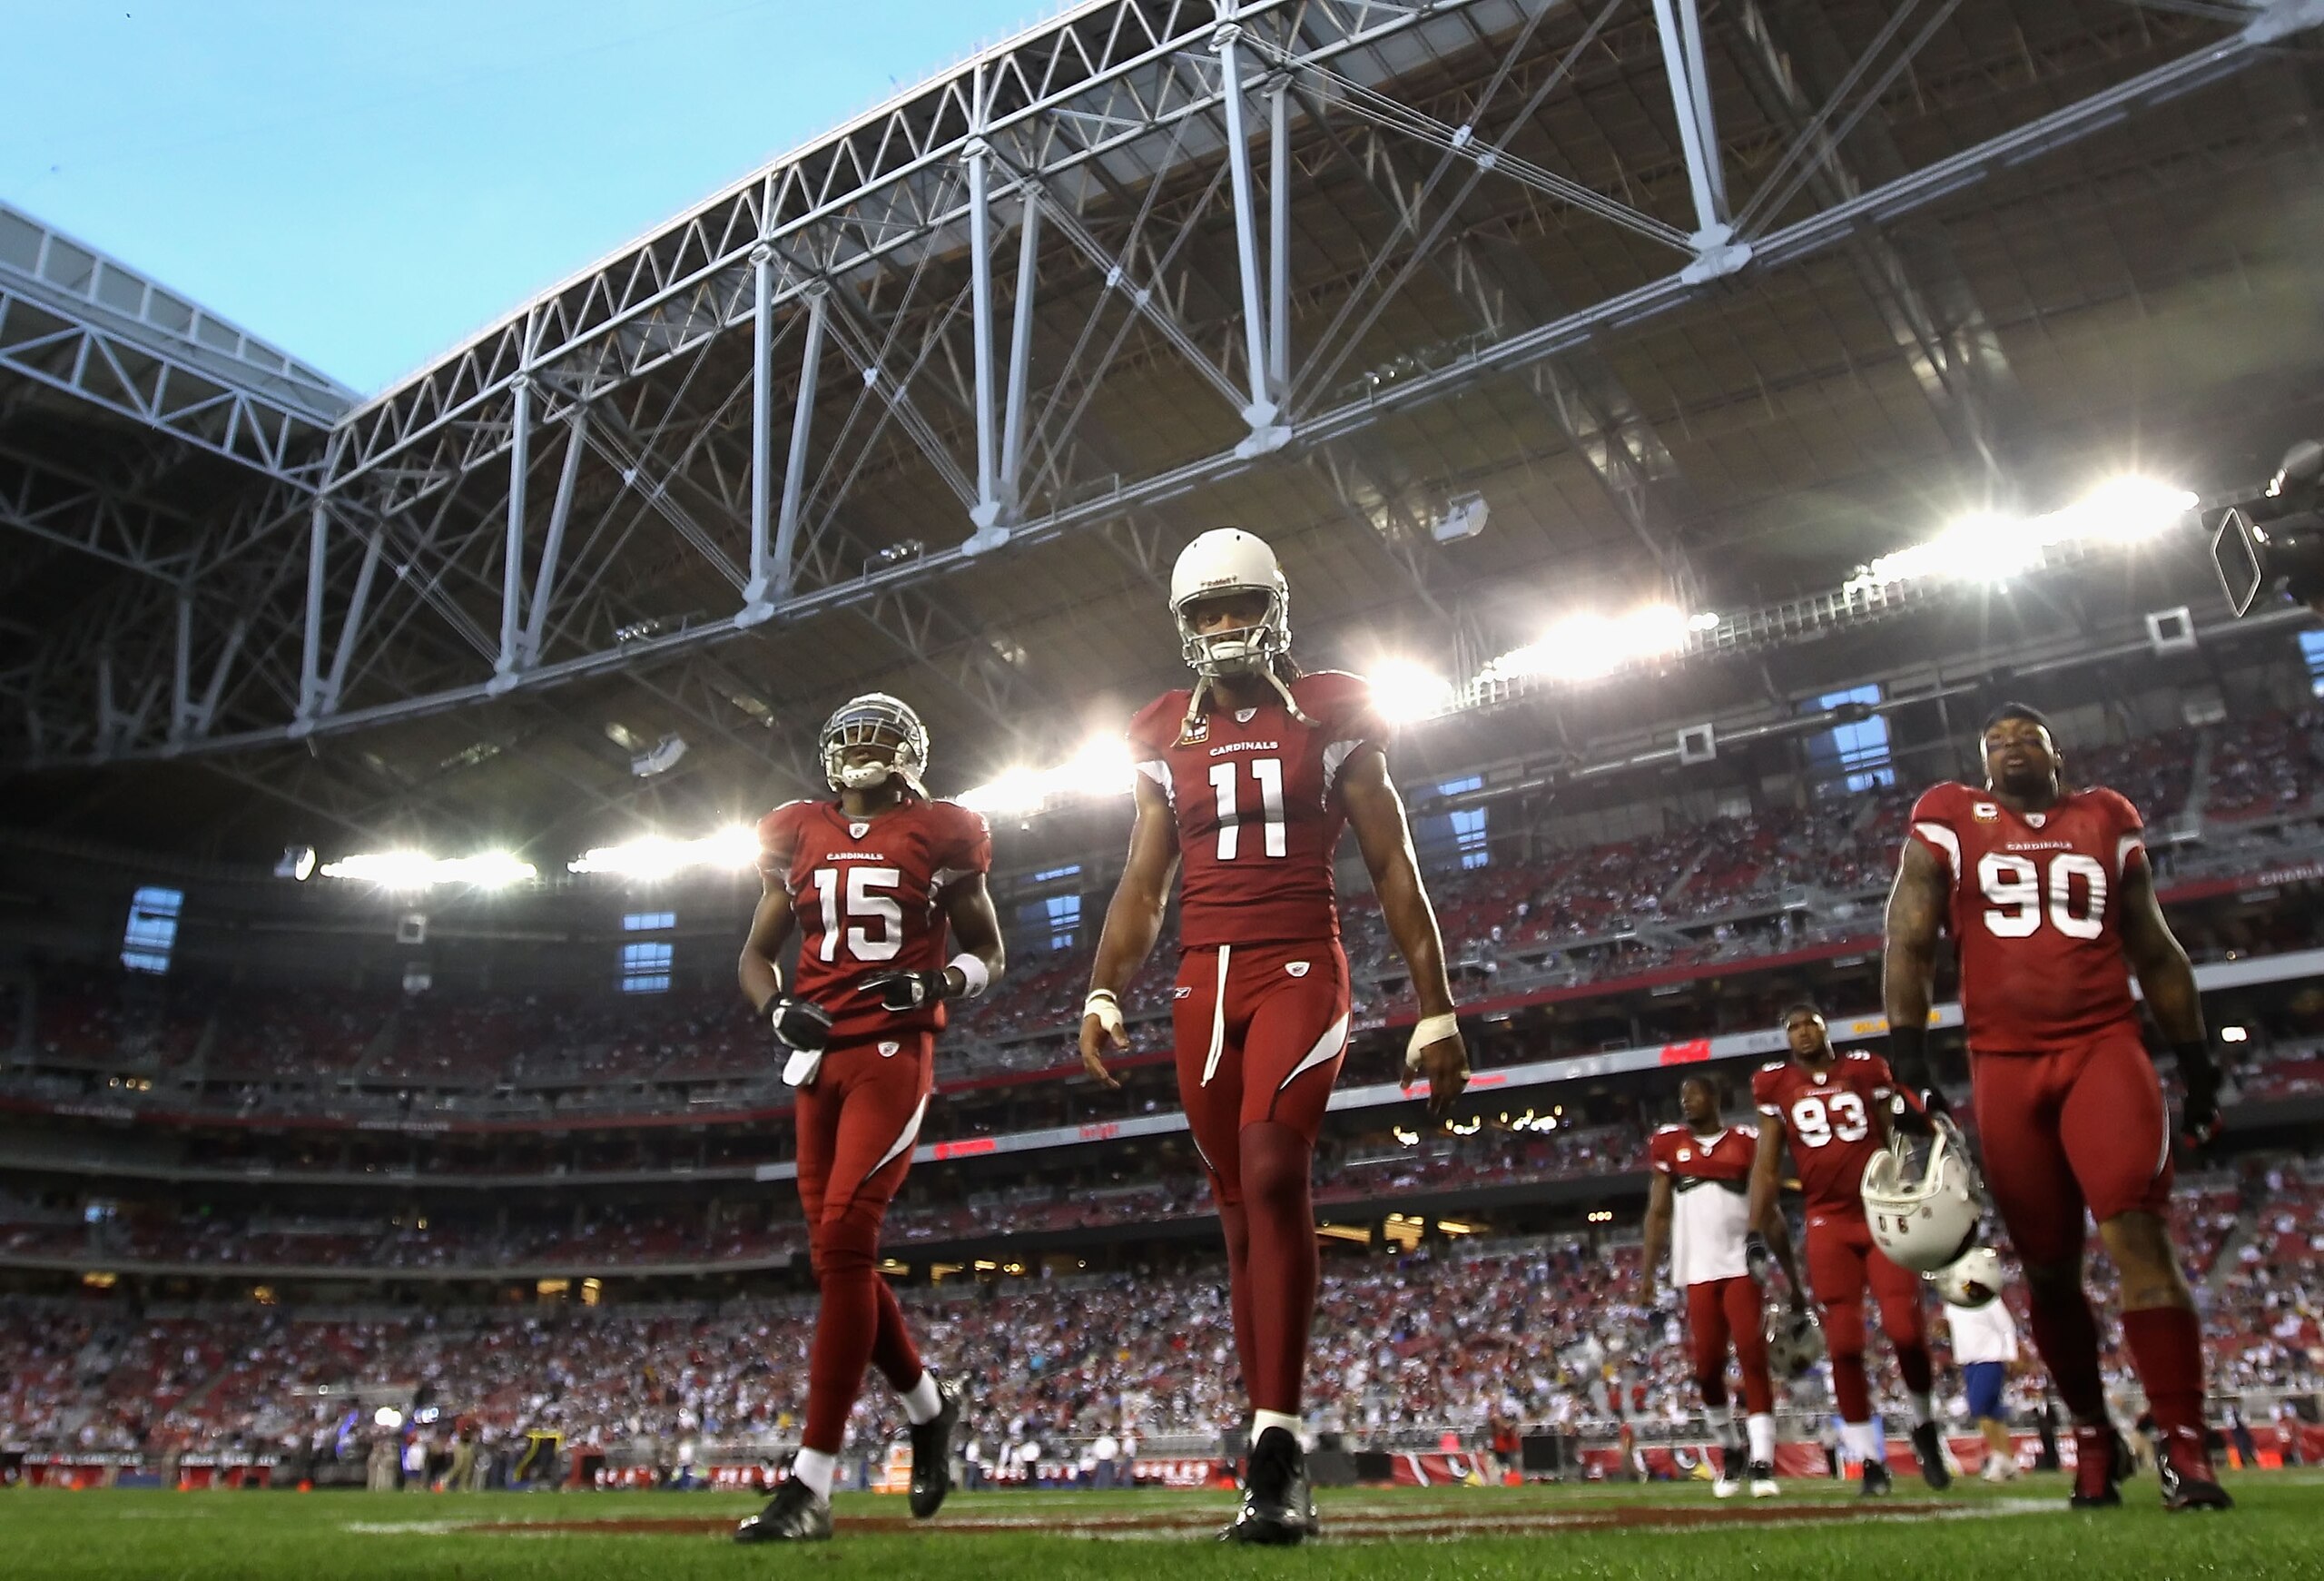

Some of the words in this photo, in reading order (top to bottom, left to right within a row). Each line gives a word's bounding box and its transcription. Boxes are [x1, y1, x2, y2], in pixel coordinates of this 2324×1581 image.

[1209, 741, 1279, 756] CARDINALS
[1208, 757, 1286, 860] 11
[826, 853, 884, 861] CARDINALS
[813, 866, 902, 962] 15
[1977, 852, 2107, 940] 90
[1791, 1092, 1868, 1148] 93
